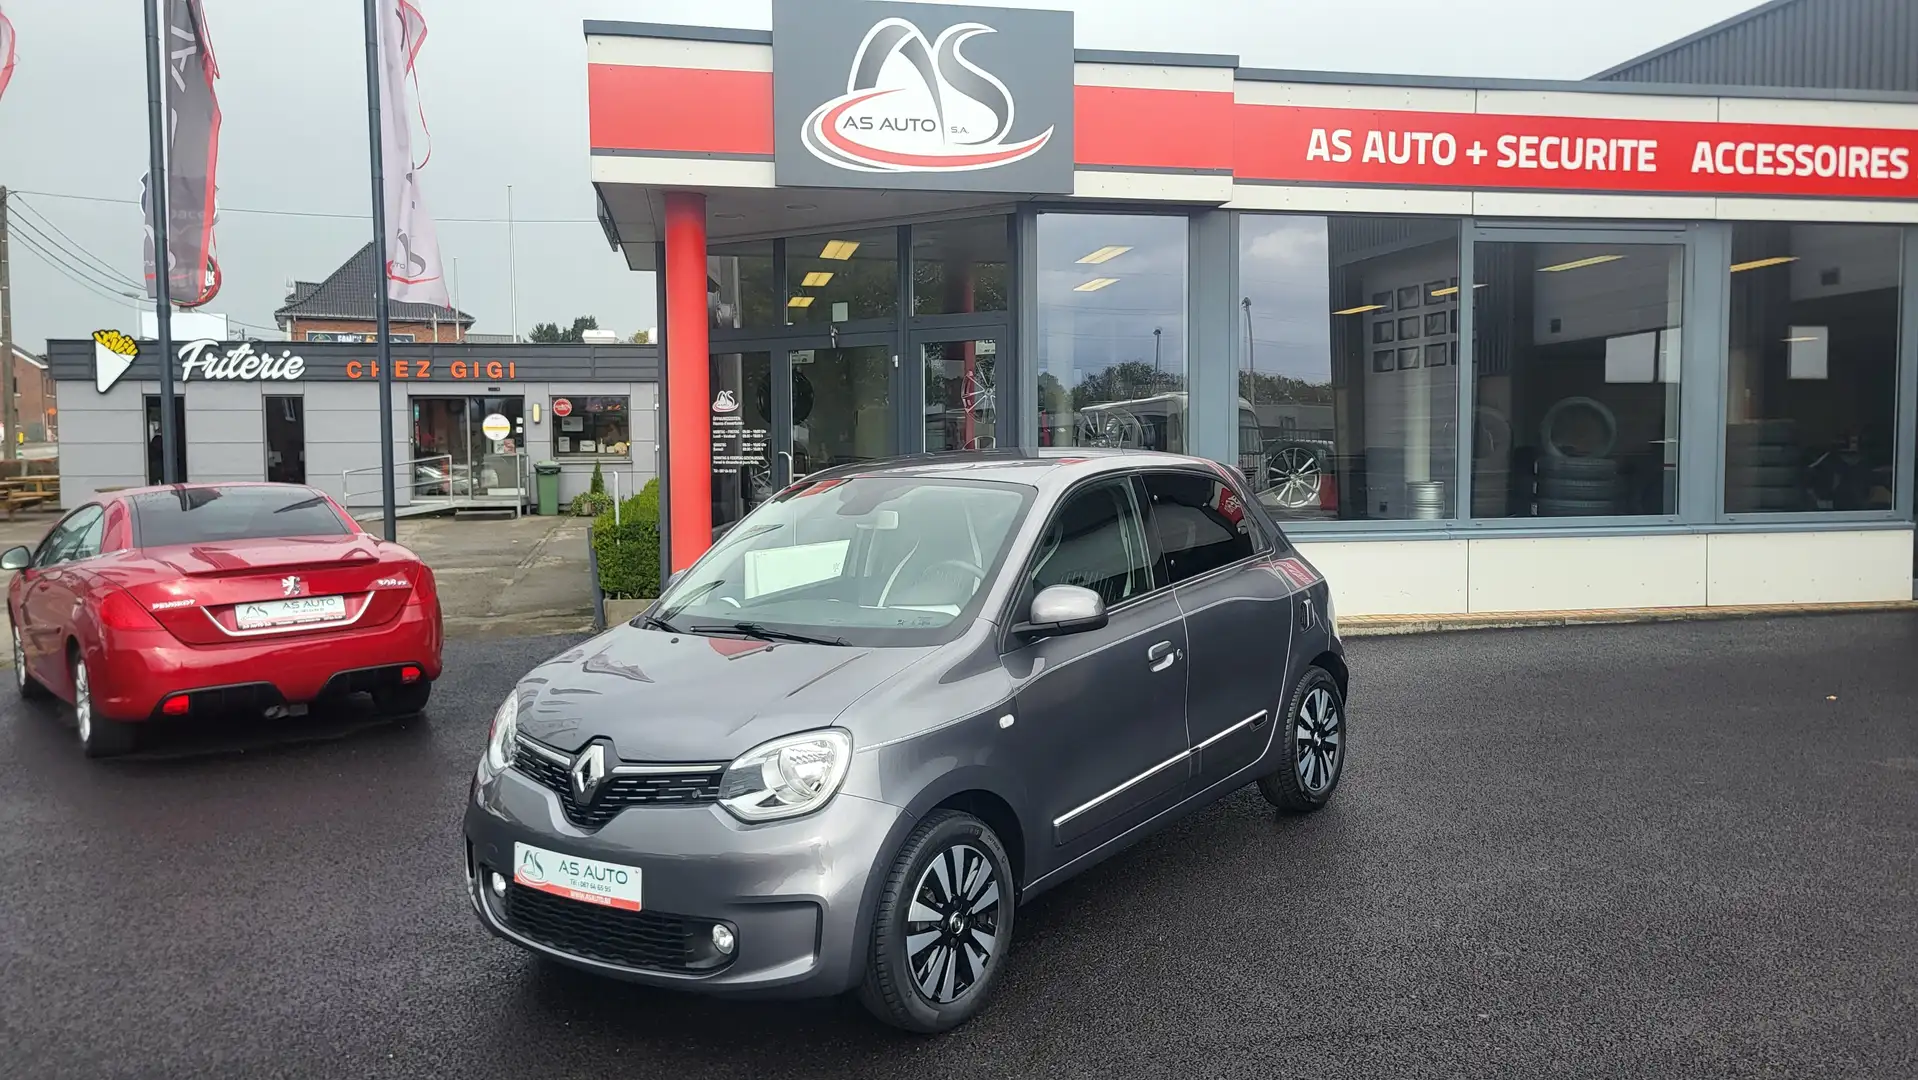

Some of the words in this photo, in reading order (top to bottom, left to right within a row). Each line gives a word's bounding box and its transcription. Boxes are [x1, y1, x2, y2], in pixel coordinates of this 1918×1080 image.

[843, 116, 873, 130] AS
[879, 118, 936, 132] AUTO
[950, 126, 970, 134] S.A.
[1306, 128, 1352, 162] AS
[1361, 130, 1457, 166] AUTO
[1465, 140, 1488, 165] +
[1496, 135, 1658, 172] SECURITE
[1690, 140, 1910, 180] ACCESSOIRES
[178, 339, 306, 381] Friterie
[450, 360, 516, 379] GIGI
[283, 601, 299, 609] AS
[303, 598, 335, 608] AUTO
[558, 860, 580, 876] AS
[583, 865, 628, 885] AUTO
